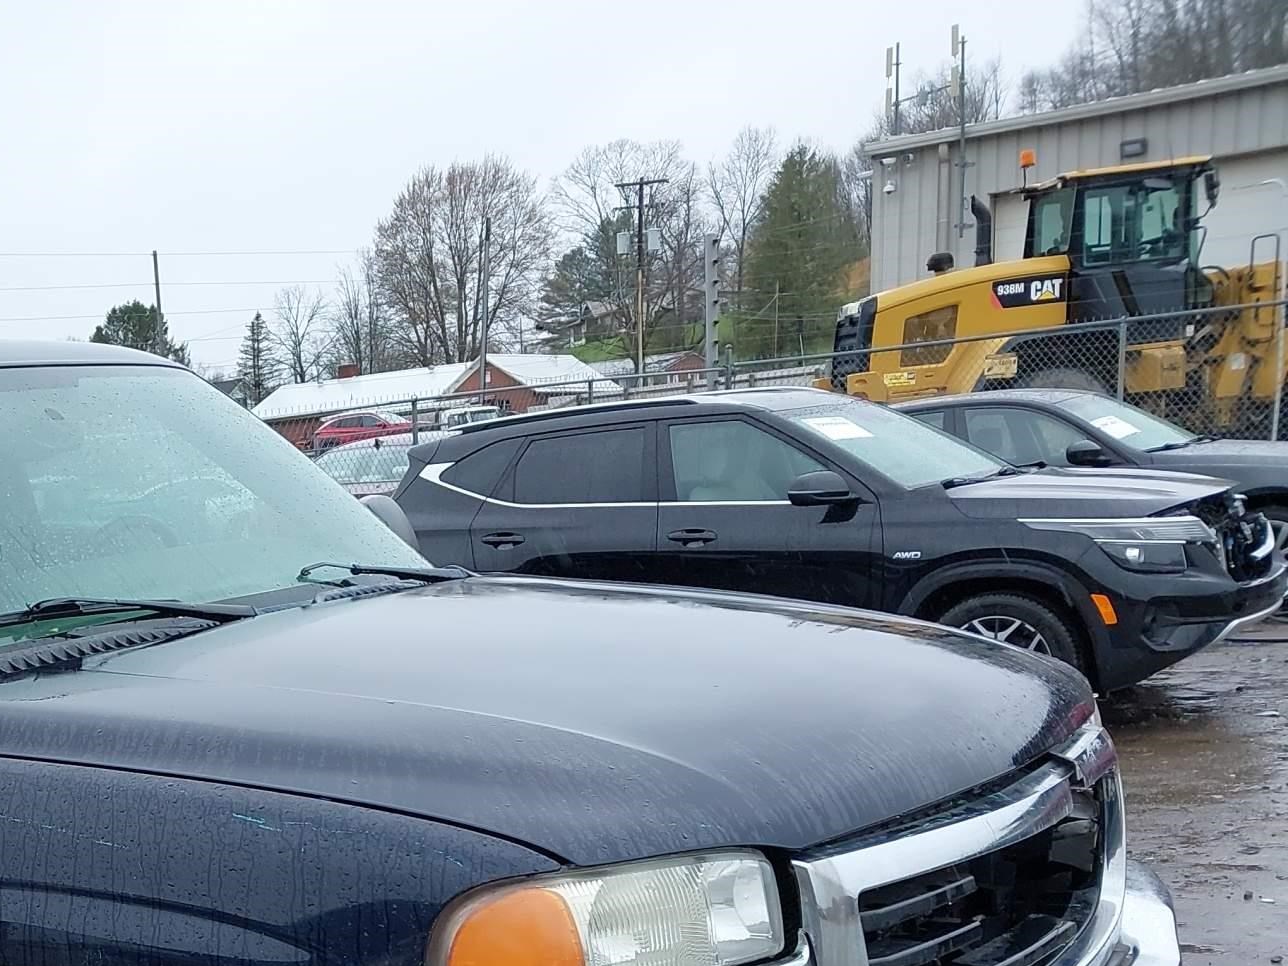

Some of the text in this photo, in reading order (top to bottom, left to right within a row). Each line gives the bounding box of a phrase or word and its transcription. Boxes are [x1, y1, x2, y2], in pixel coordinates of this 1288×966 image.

[997, 278, 1063, 300] 938M CAT
[892, 551, 921, 559] AWD
